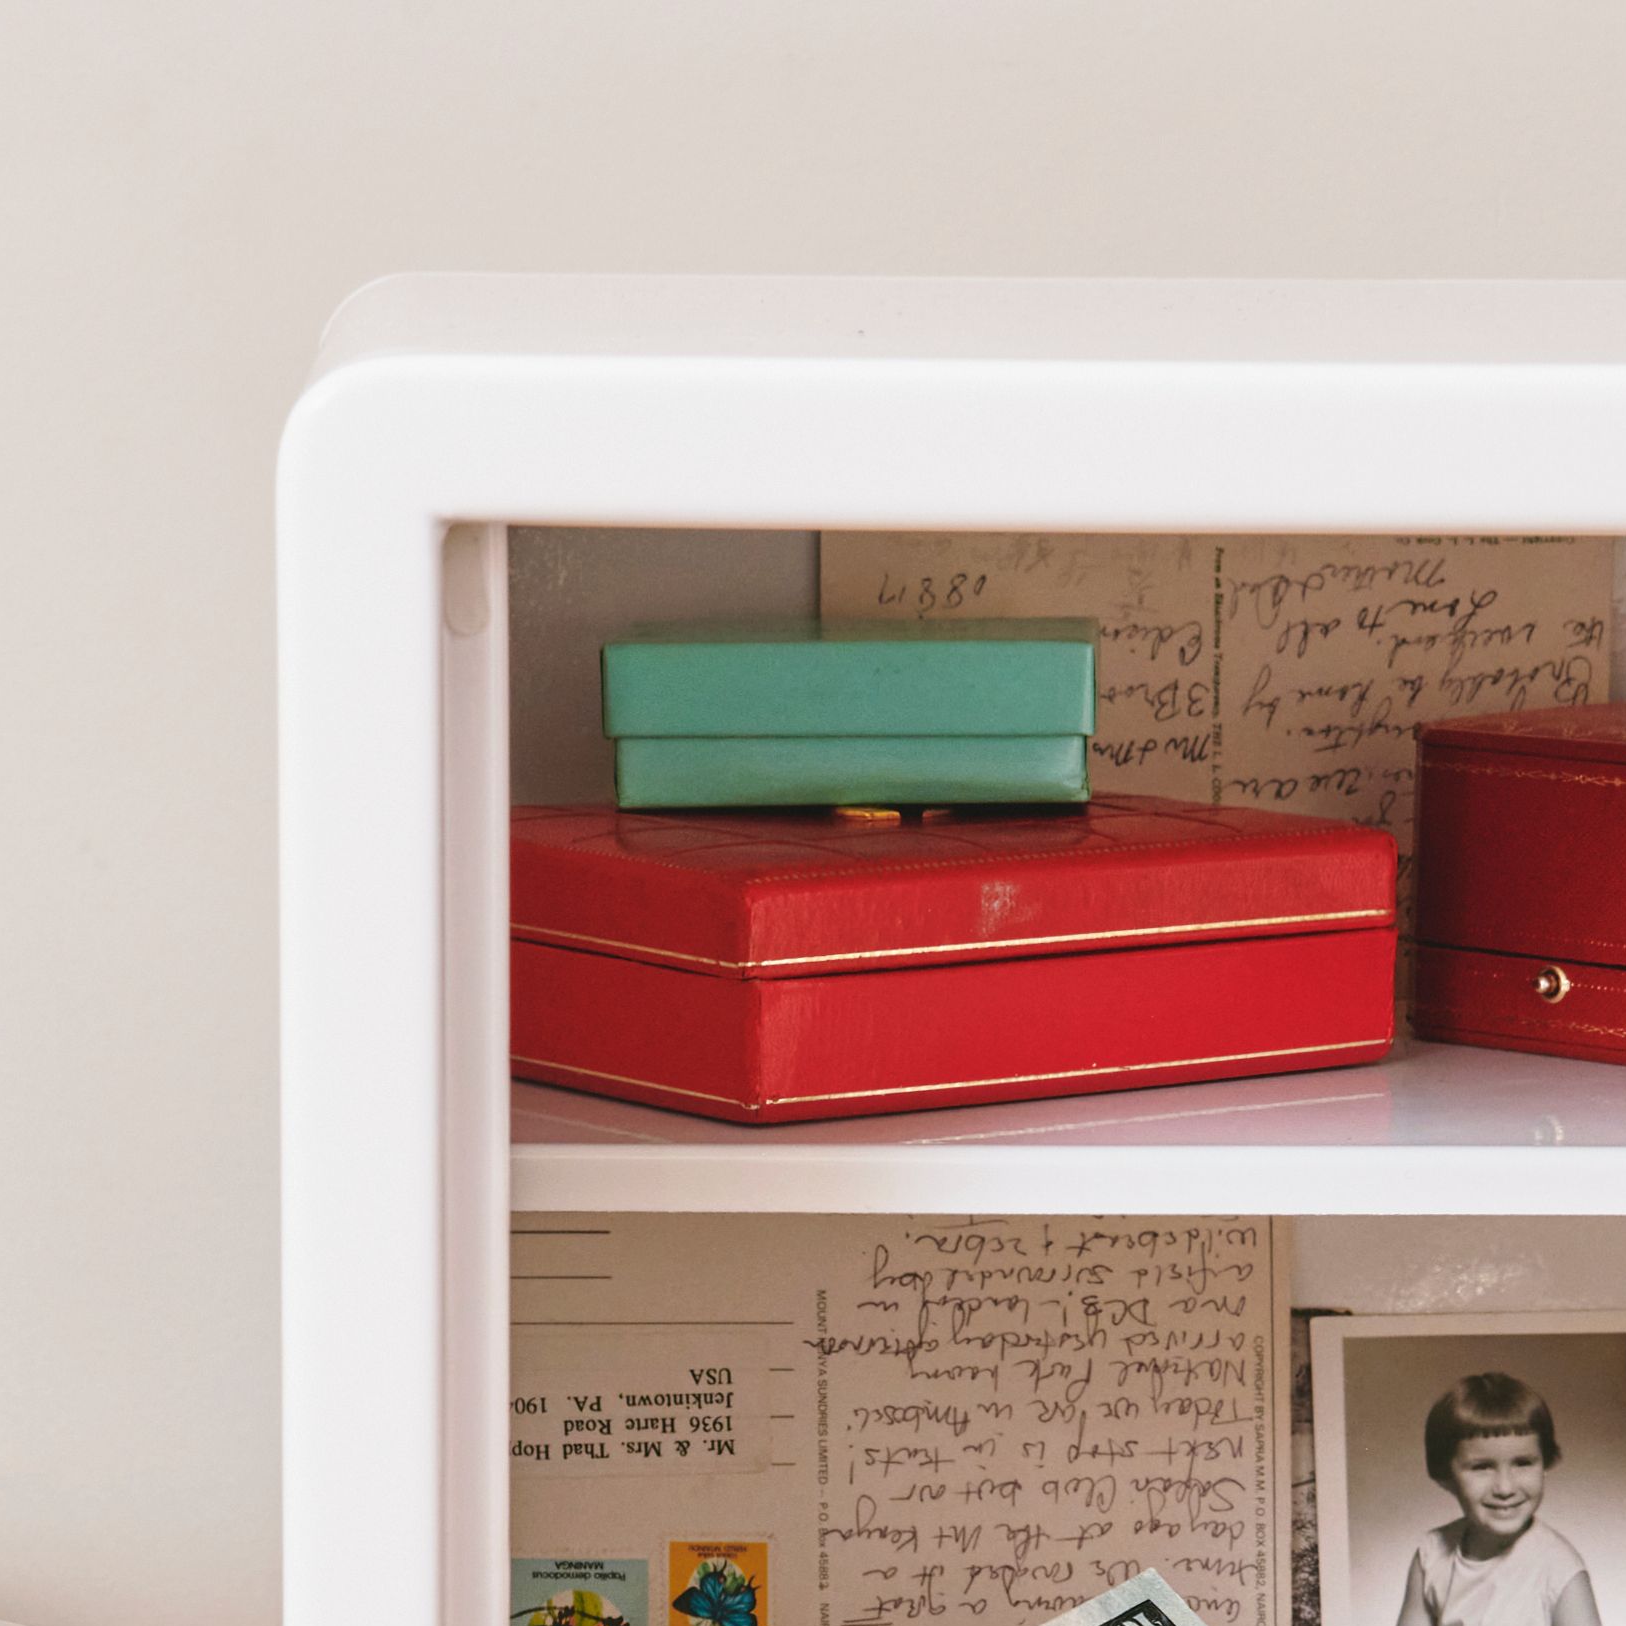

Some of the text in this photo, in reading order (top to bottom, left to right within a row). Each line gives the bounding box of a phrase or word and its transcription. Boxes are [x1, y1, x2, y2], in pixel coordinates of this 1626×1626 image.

[1186, 683, 1209, 717] 3
[816, 1289, 828, 1334] MOUNT
[689, 1368, 733, 1385] USA
[1253, 1336, 1265, 1402] COPYRIGHT
[567, 1391, 734, 1411] Jenkintown, PA.
[563, 1415, 733, 1435] 1936 Harte Road
[1254, 1406, 1265, 1423] BY
[562, 1439, 735, 1459] Mr. & Mrs. Thad
[817, 1439, 829, 1485] LIMITED
[1255, 1523, 1266, 1548] BOX
